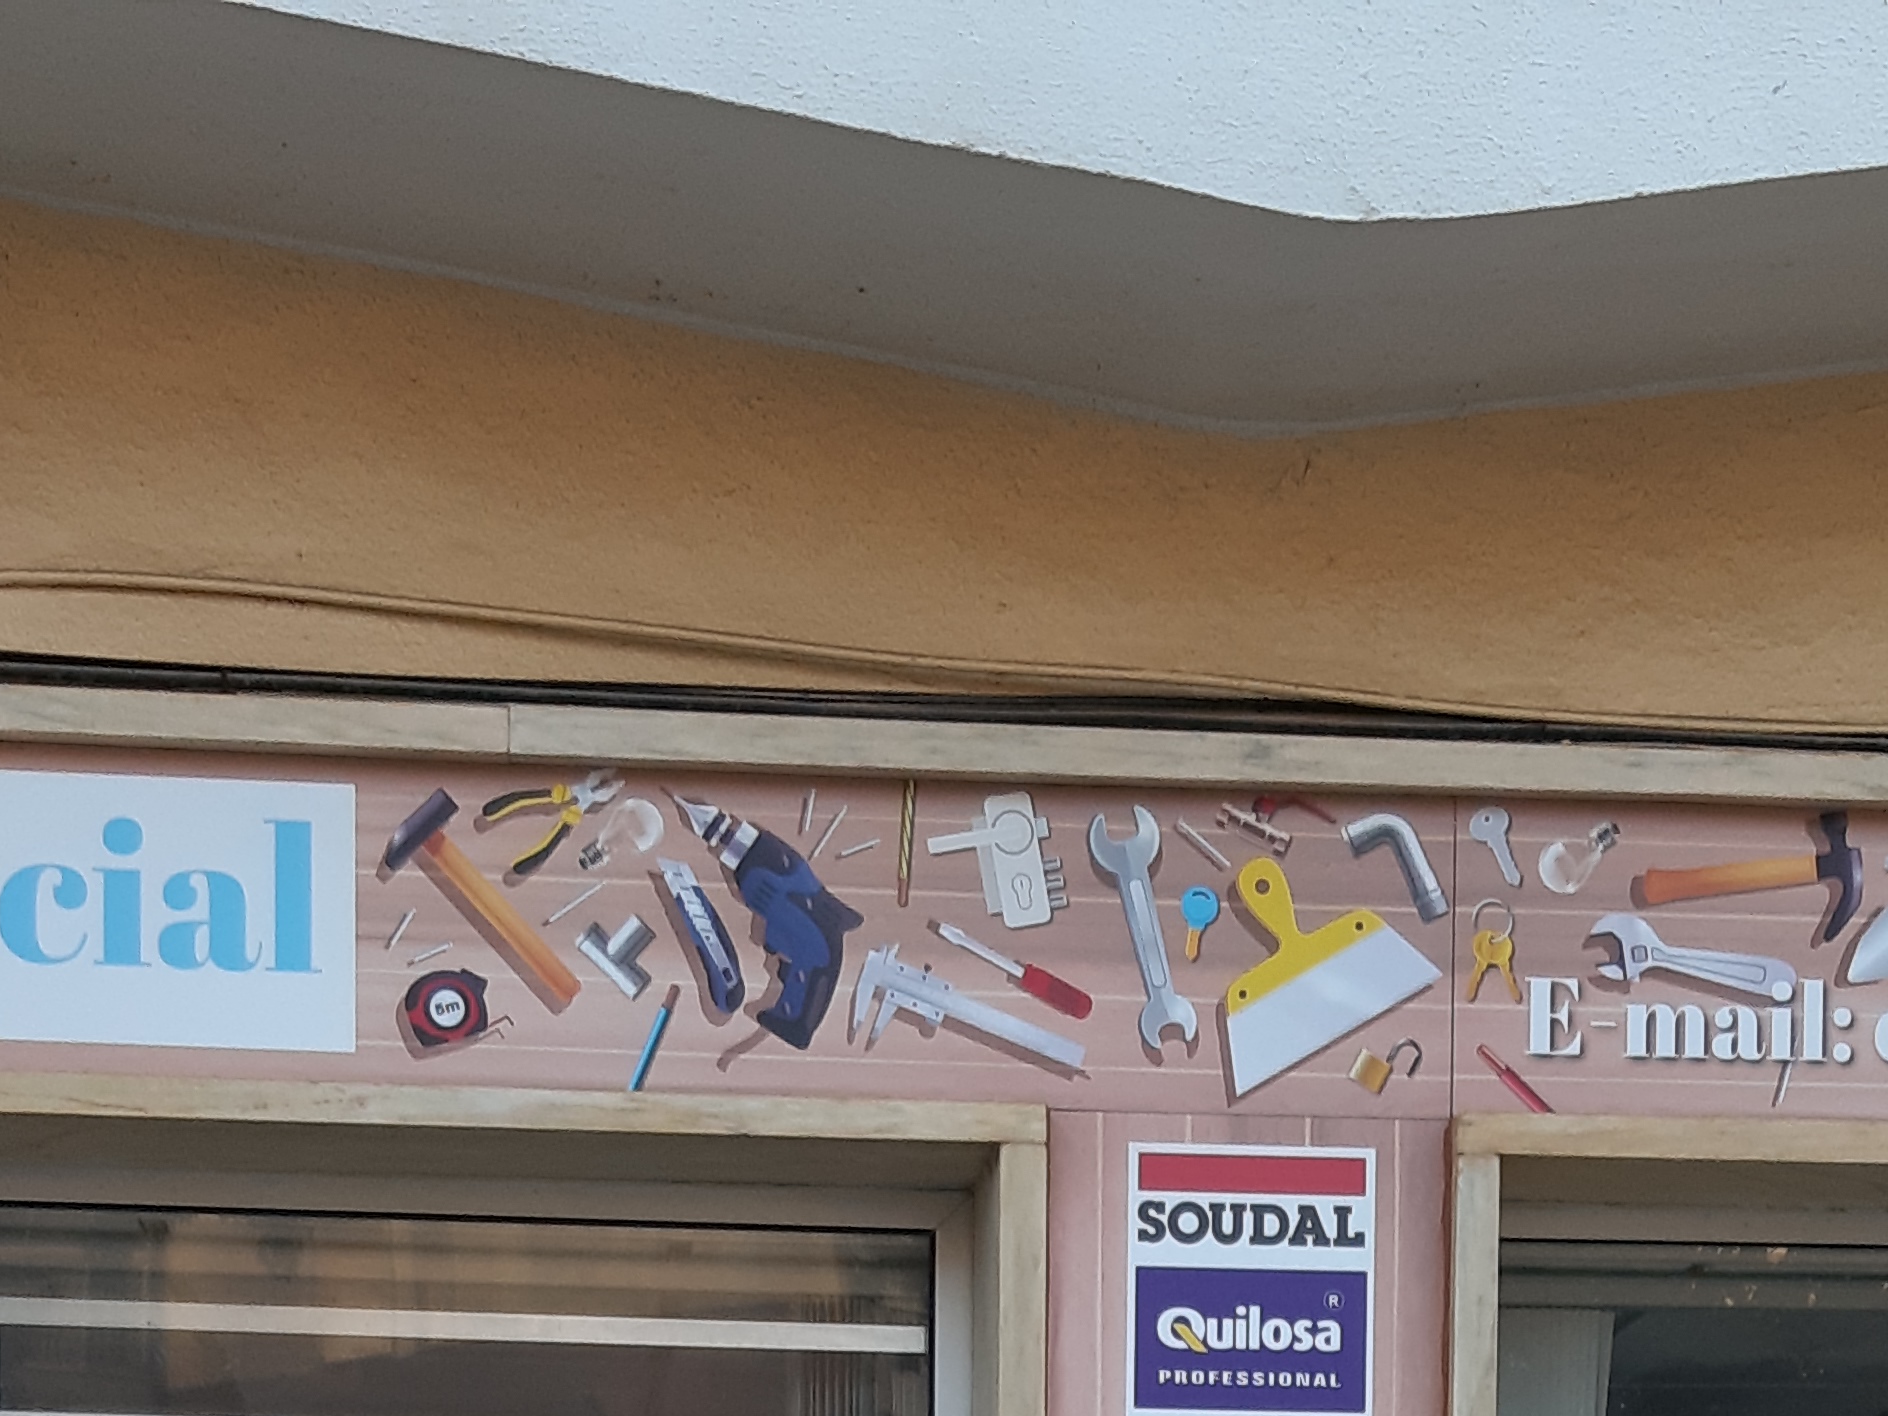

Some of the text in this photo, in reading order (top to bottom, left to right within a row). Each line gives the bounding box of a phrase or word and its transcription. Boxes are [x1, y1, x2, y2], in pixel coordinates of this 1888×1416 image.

[1524, 974, 1854, 1064] E-mail:
[1136, 1200, 1367, 1249] SOUDAL
[1156, 1305, 1343, 1354] Quilosa
[1157, 1369, 1343, 1390] PROFESSIONAL
